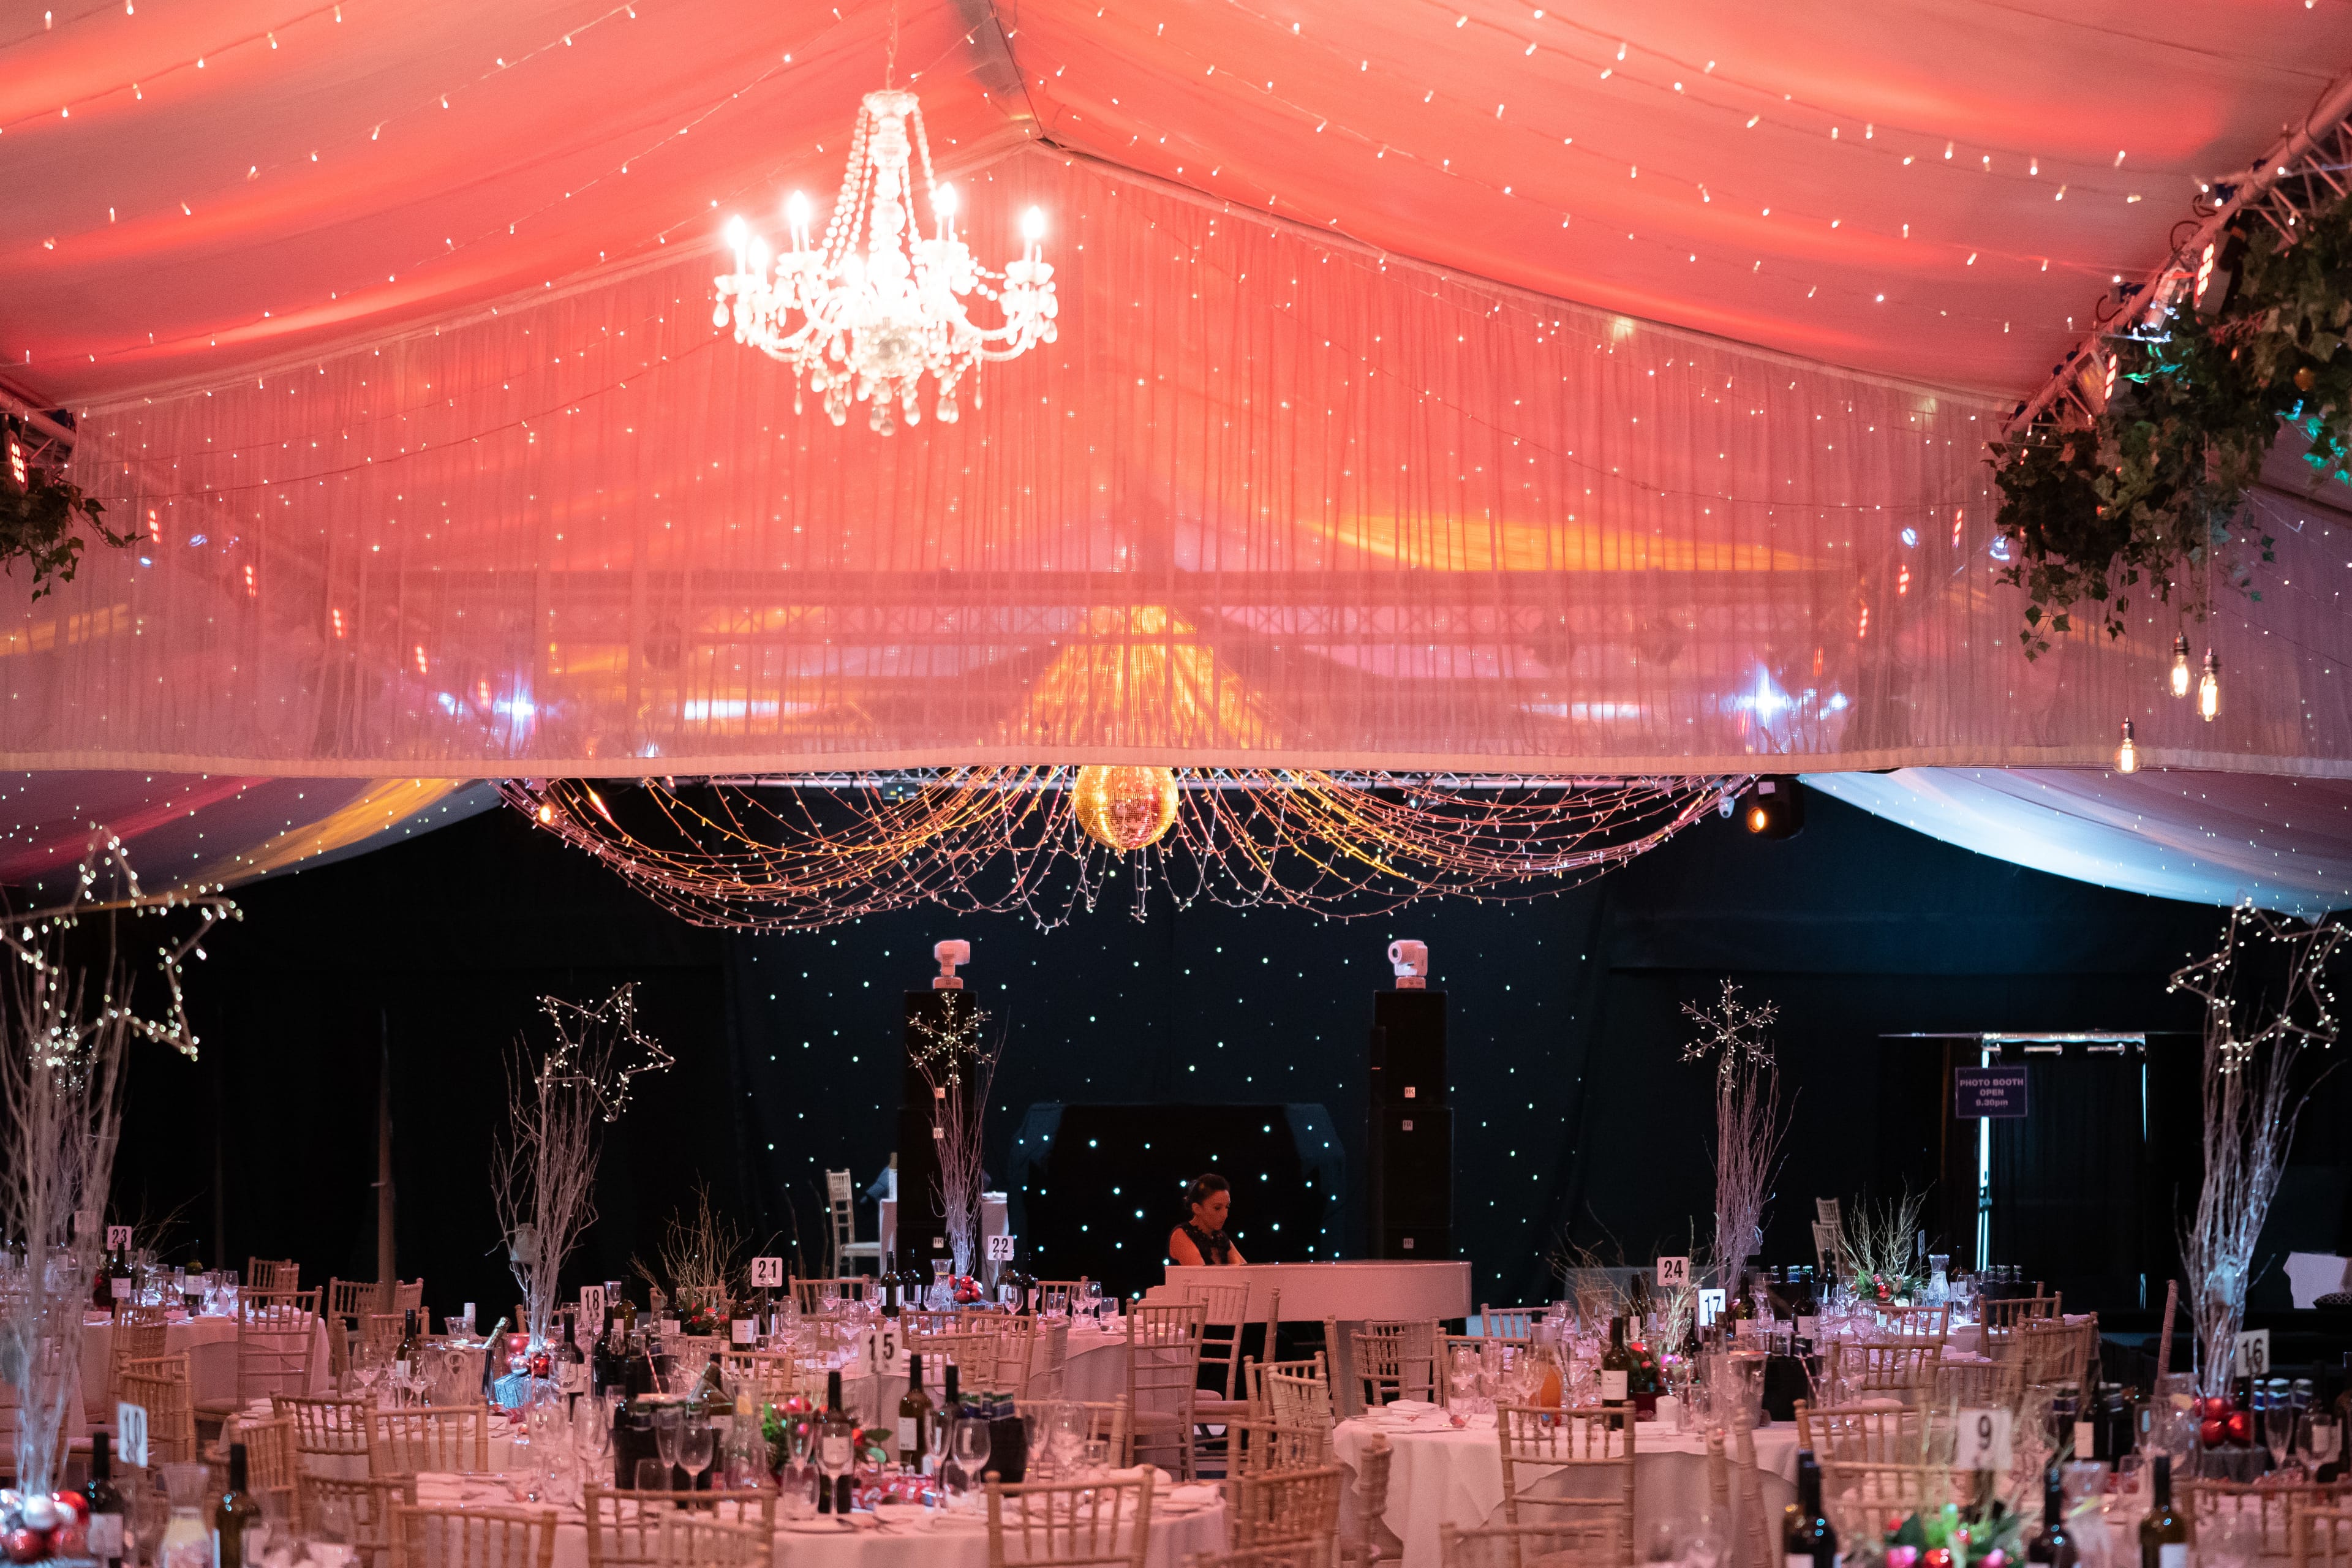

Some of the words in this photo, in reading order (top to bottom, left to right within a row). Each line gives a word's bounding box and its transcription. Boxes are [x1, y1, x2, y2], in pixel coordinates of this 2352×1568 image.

[113, 1229, 127, 1243] 23
[992, 1237, 1008, 1253] 22
[758, 1260, 776, 1278] 21
[1664, 1260, 1683, 1278] 24
[586, 1289, 600, 1311] 18
[1705, 1296, 1721, 1319] 17
[869, 1333, 895, 1361] 15
[2243, 1338, 2263, 1368] 16
[1978, 1415, 1991, 1450] 9
